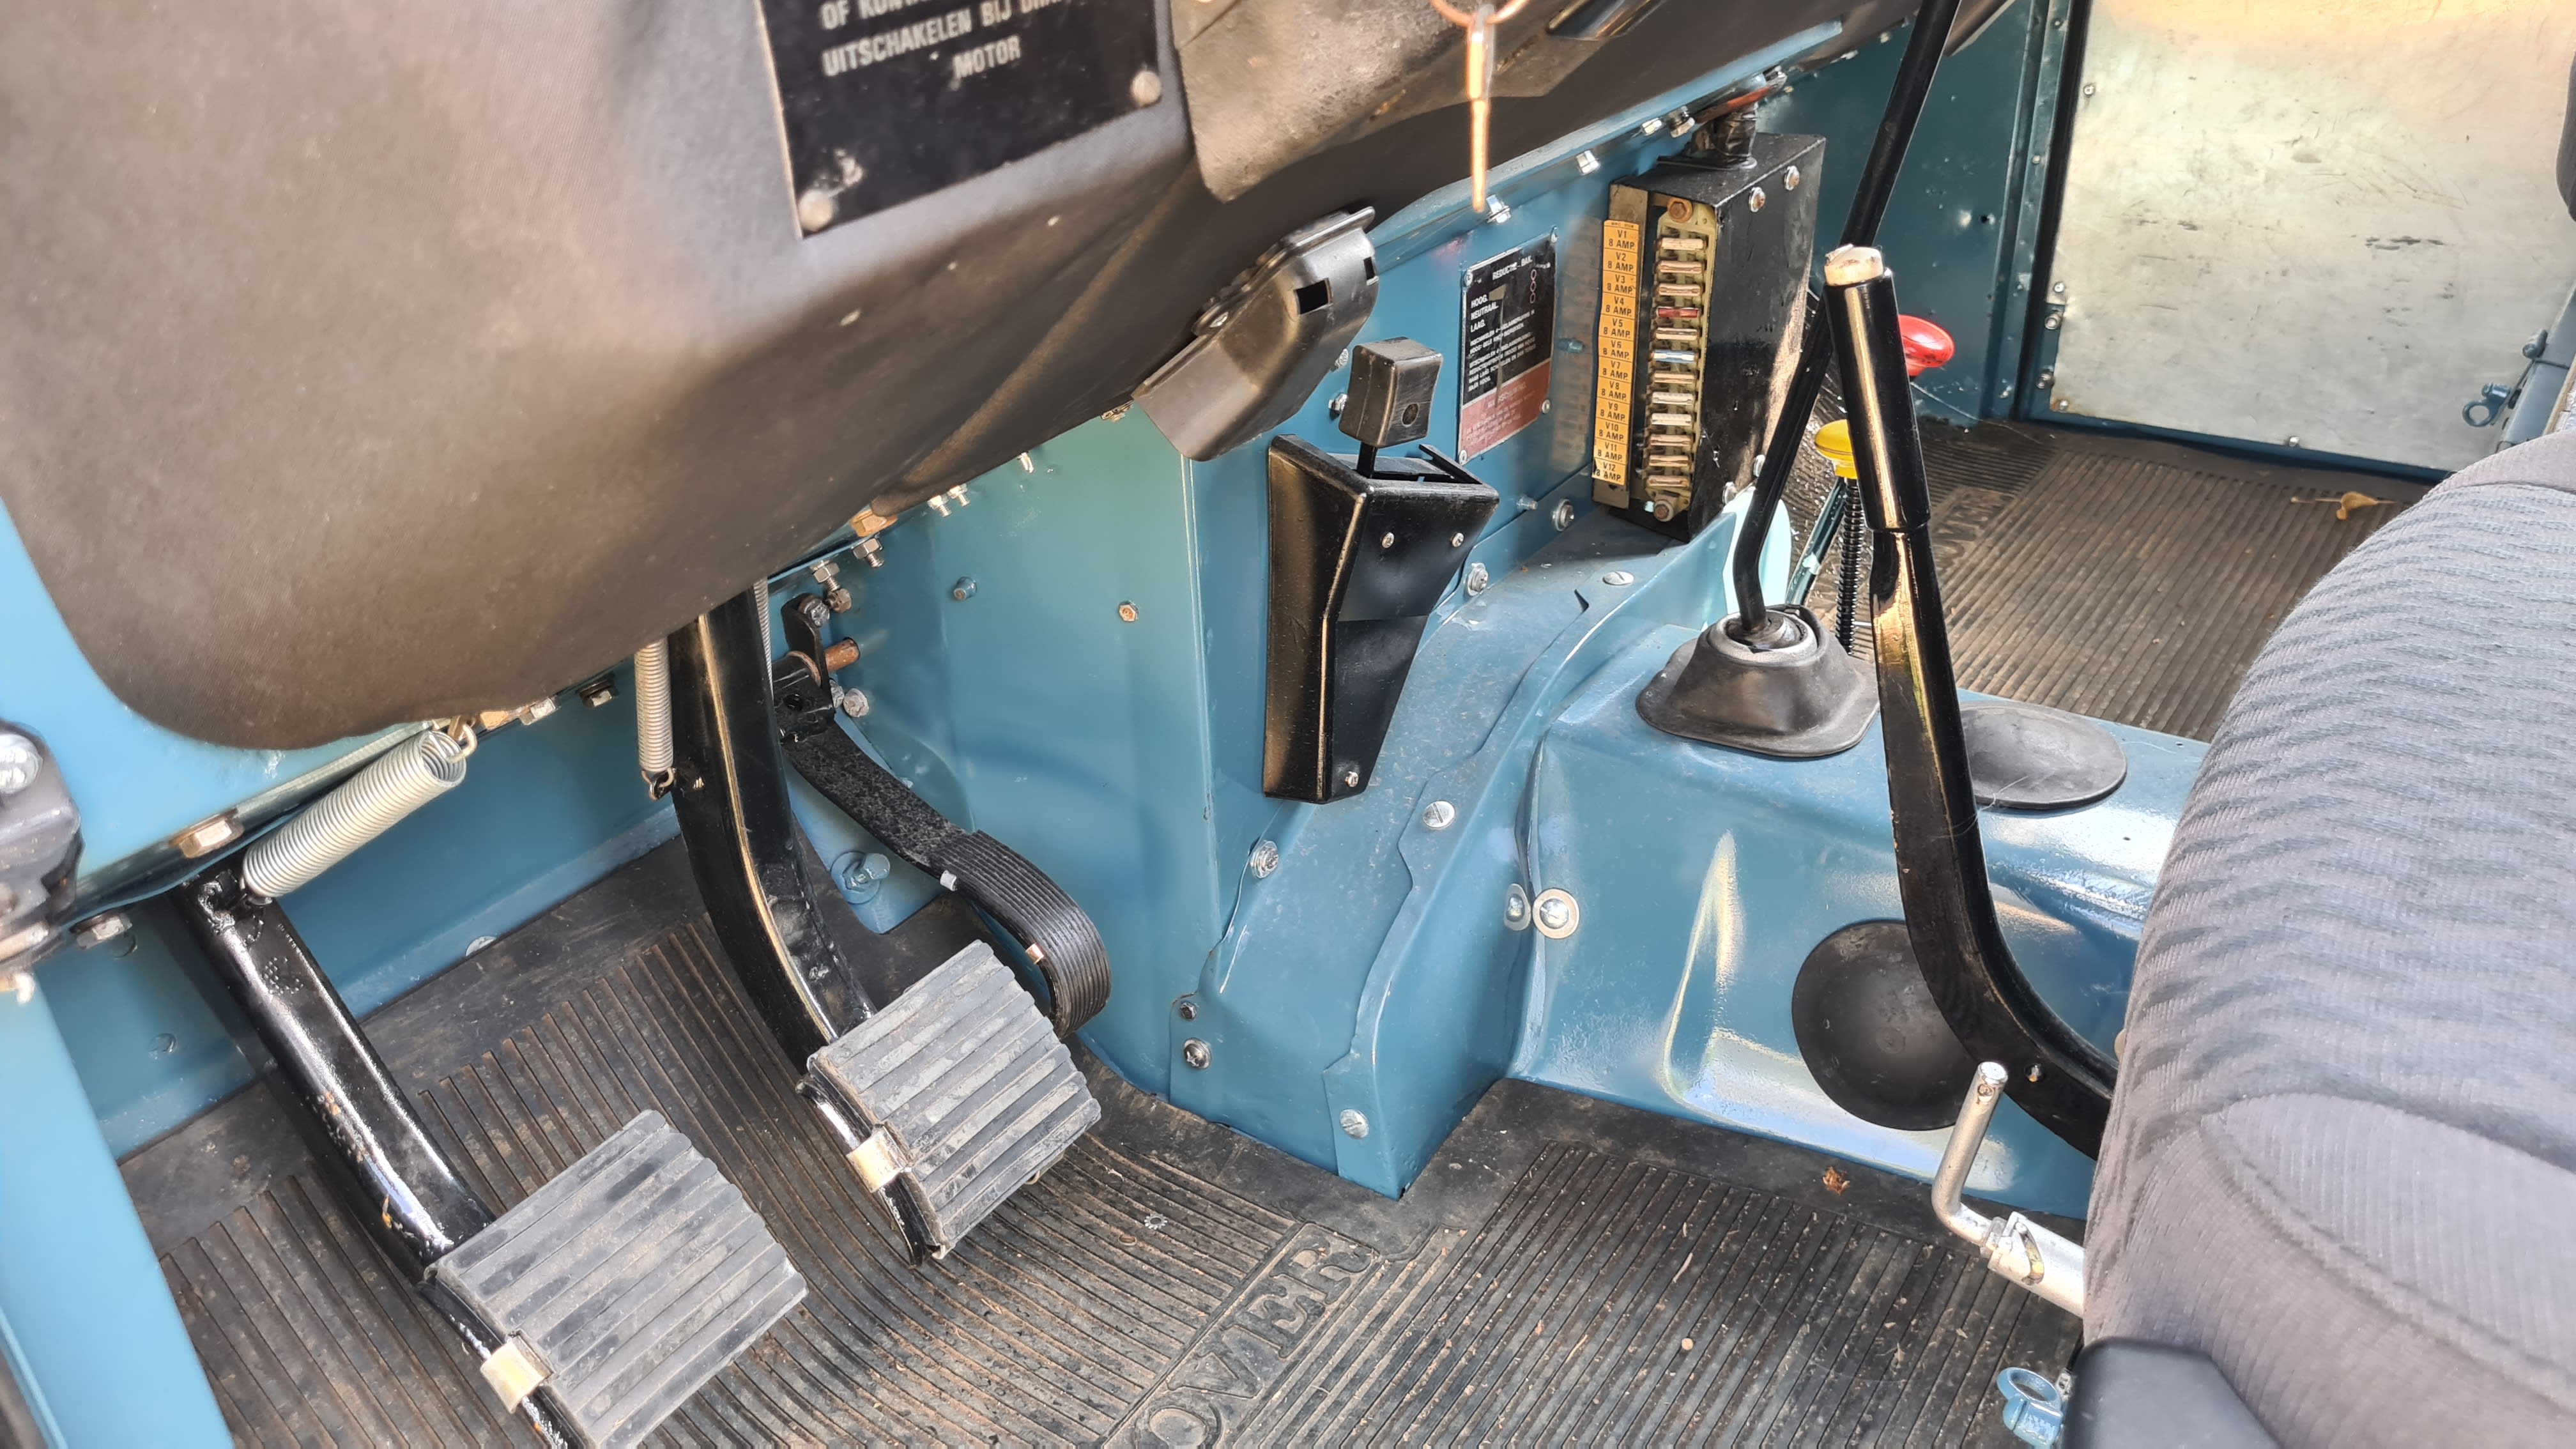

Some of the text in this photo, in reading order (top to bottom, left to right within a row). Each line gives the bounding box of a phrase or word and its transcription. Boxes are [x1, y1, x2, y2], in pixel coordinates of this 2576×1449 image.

[820, 0, 850, 30] OF
[822, 8, 972, 77] UITSCHAKELEN
[979, 0, 1013, 27] BIJ
[951, 34, 1022, 79] MOTOR
[1617, 229, 1627, 239] V1
[1609, 238, 1613, 247] 8
[1616, 252, 1626, 261] V2
[1607, 261, 1612, 269] 8
[1614, 274, 1625, 284] V3
[1607, 282, 1611, 291] 8
[1471, 294, 1489, 309] HOOG.
[1614, 296, 1624, 305] V4
[1471, 302, 1499, 320] NEUTRAAL.
[1606, 304, 1610, 312] 8
[1470, 319, 1486, 333] LAAG.
[1612, 318, 1623, 327] V5
[1604, 326, 1608, 335] 8
[1611, 340, 1621, 348] V6
[1611, 360, 1620, 369] V7
[1602, 367, 1607, 376] 8
[1609, 380, 1620, 390] V8
[1601, 388, 1606, 396] 8
[1608, 402, 1618, 411] V9
[1606, 421, 1619, 431] V10
[1599, 429, 1603, 437] 8
[1605, 441, 1617, 452] V11
[1603, 461, 1616, 471] V12
